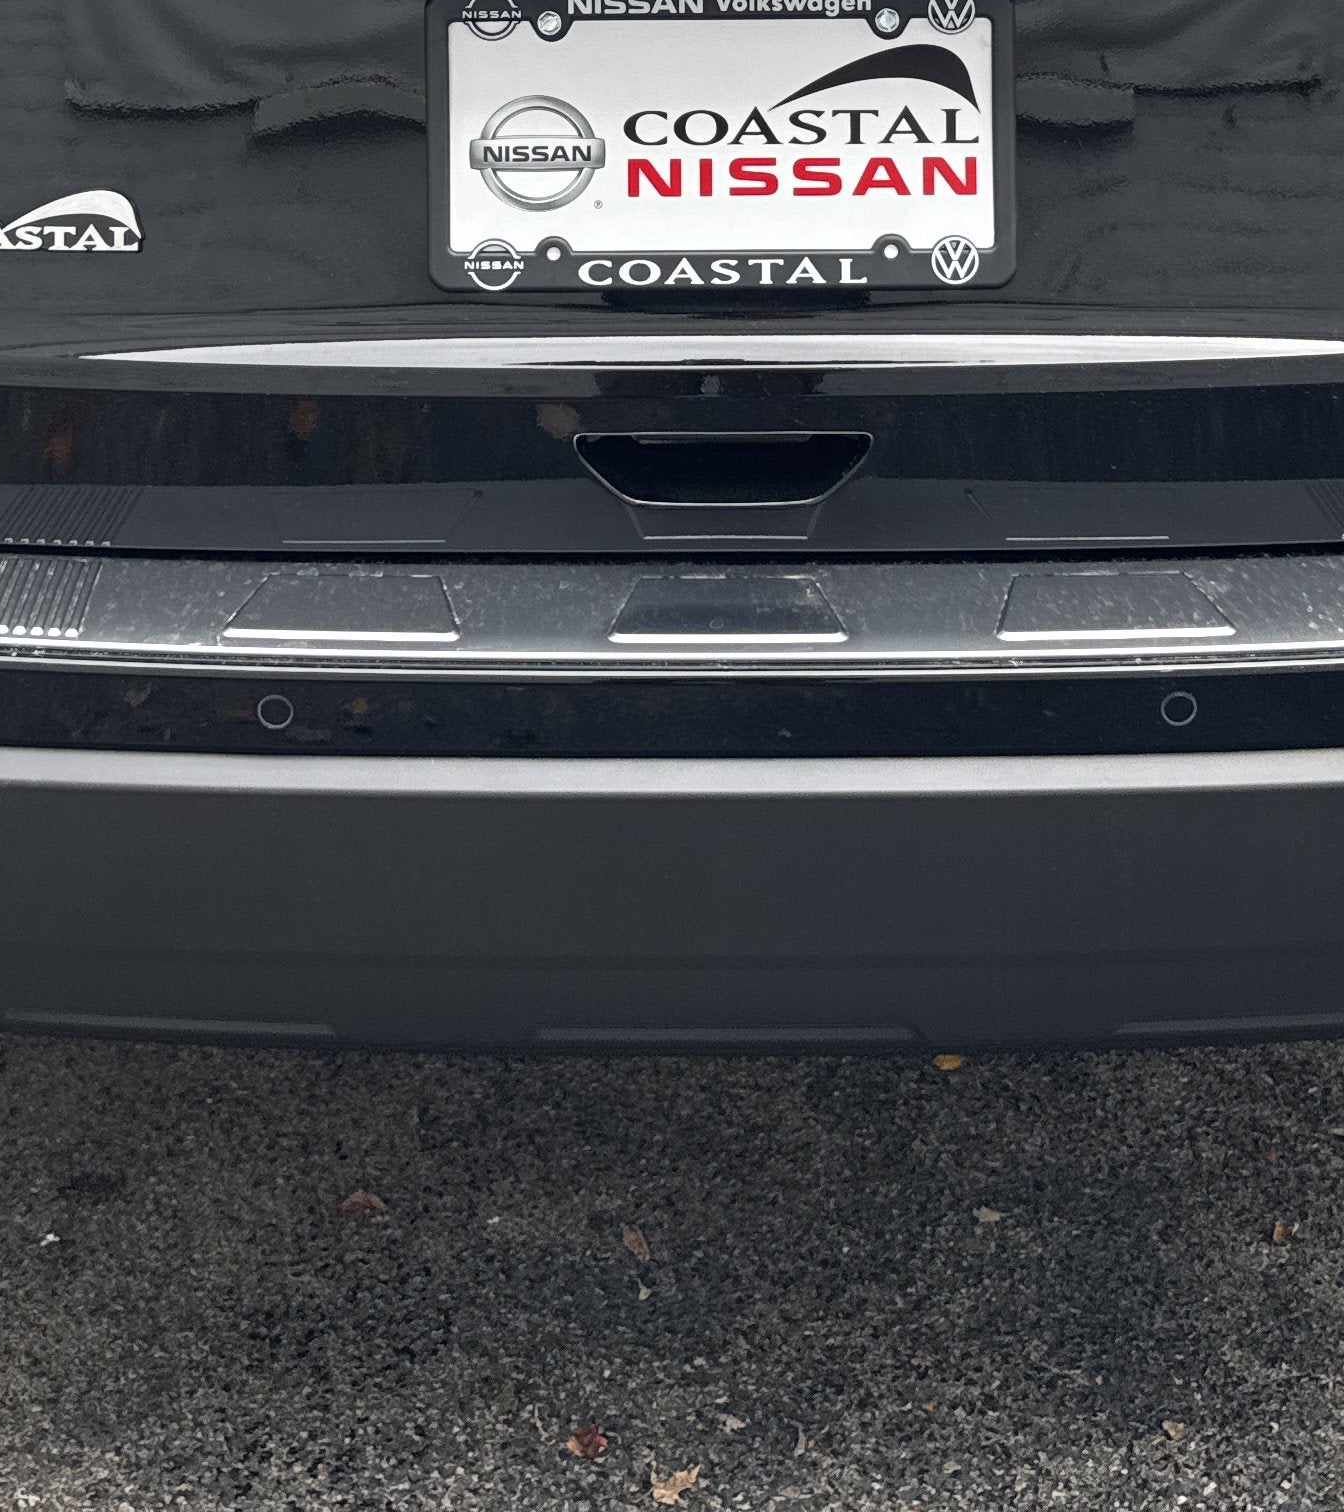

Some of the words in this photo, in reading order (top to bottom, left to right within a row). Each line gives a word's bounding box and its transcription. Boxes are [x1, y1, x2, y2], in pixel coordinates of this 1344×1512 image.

[462, 9, 522, 20] NISSAN
[623, 106, 980, 146] COASTAL
[483, 145, 592, 163] NISSAN
[627, 156, 977, 197] NISSAN
[464, 260, 524, 271] NISSAN
[578, 257, 868, 285] COASTAL
